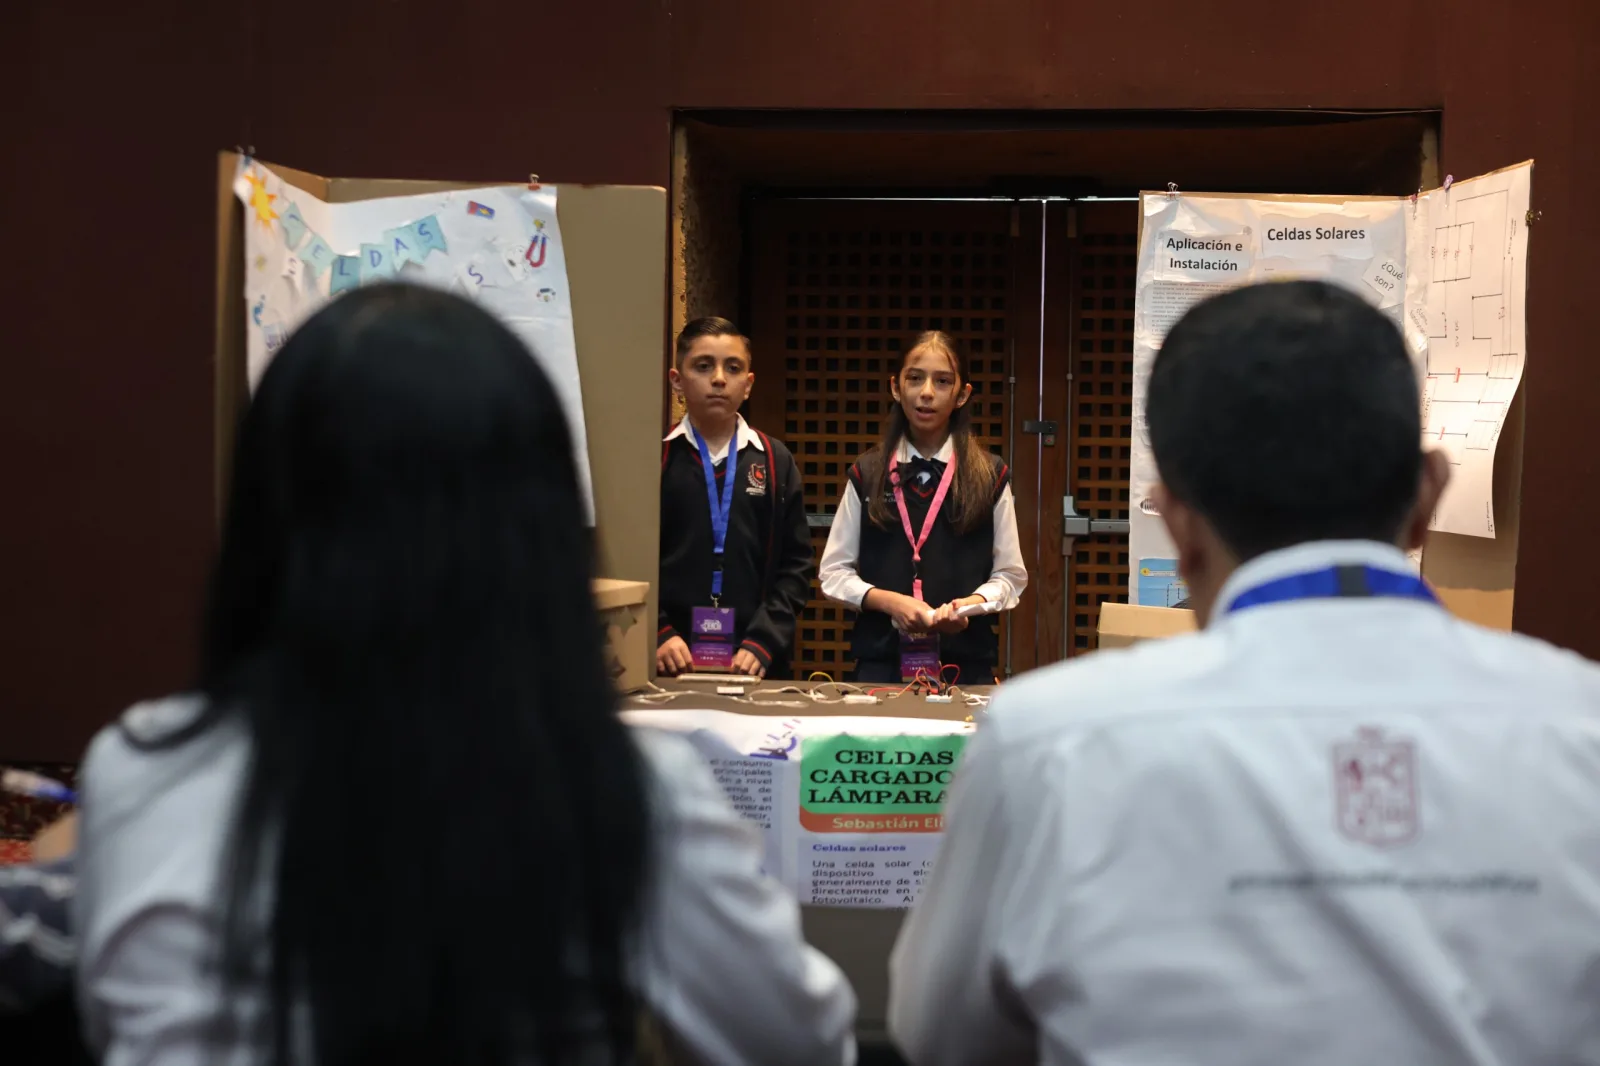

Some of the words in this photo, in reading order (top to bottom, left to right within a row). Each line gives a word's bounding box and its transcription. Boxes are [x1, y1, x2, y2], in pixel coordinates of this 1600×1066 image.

[1267, 227, 1312, 241] Celdas
[1315, 226, 1365, 240] Solares
[1166, 237, 1231, 251] Aplicación
[1235, 243, 1243, 252] e
[1170, 257, 1238, 271] Instalación
[1381, 261, 1404, 281] ¿Qué
[1374, 275, 1395, 292] son?
[835, 749, 954, 765] CELDAS
[832, 817, 919, 830] Sebastián
[812, 843, 856, 852] Celdas
[858, 844, 906, 852] solares
[812, 860, 835, 868] Una
[845, 860, 875, 869] celda
[884, 859, 912, 868] solar
[812, 869, 874, 878] dispositivo
[812, 879, 891, 887] generalmente
[896, 878, 910, 886] de
[812, 887, 889, 895] directamente
[812, 896, 885, 905] fotovoltaico.
